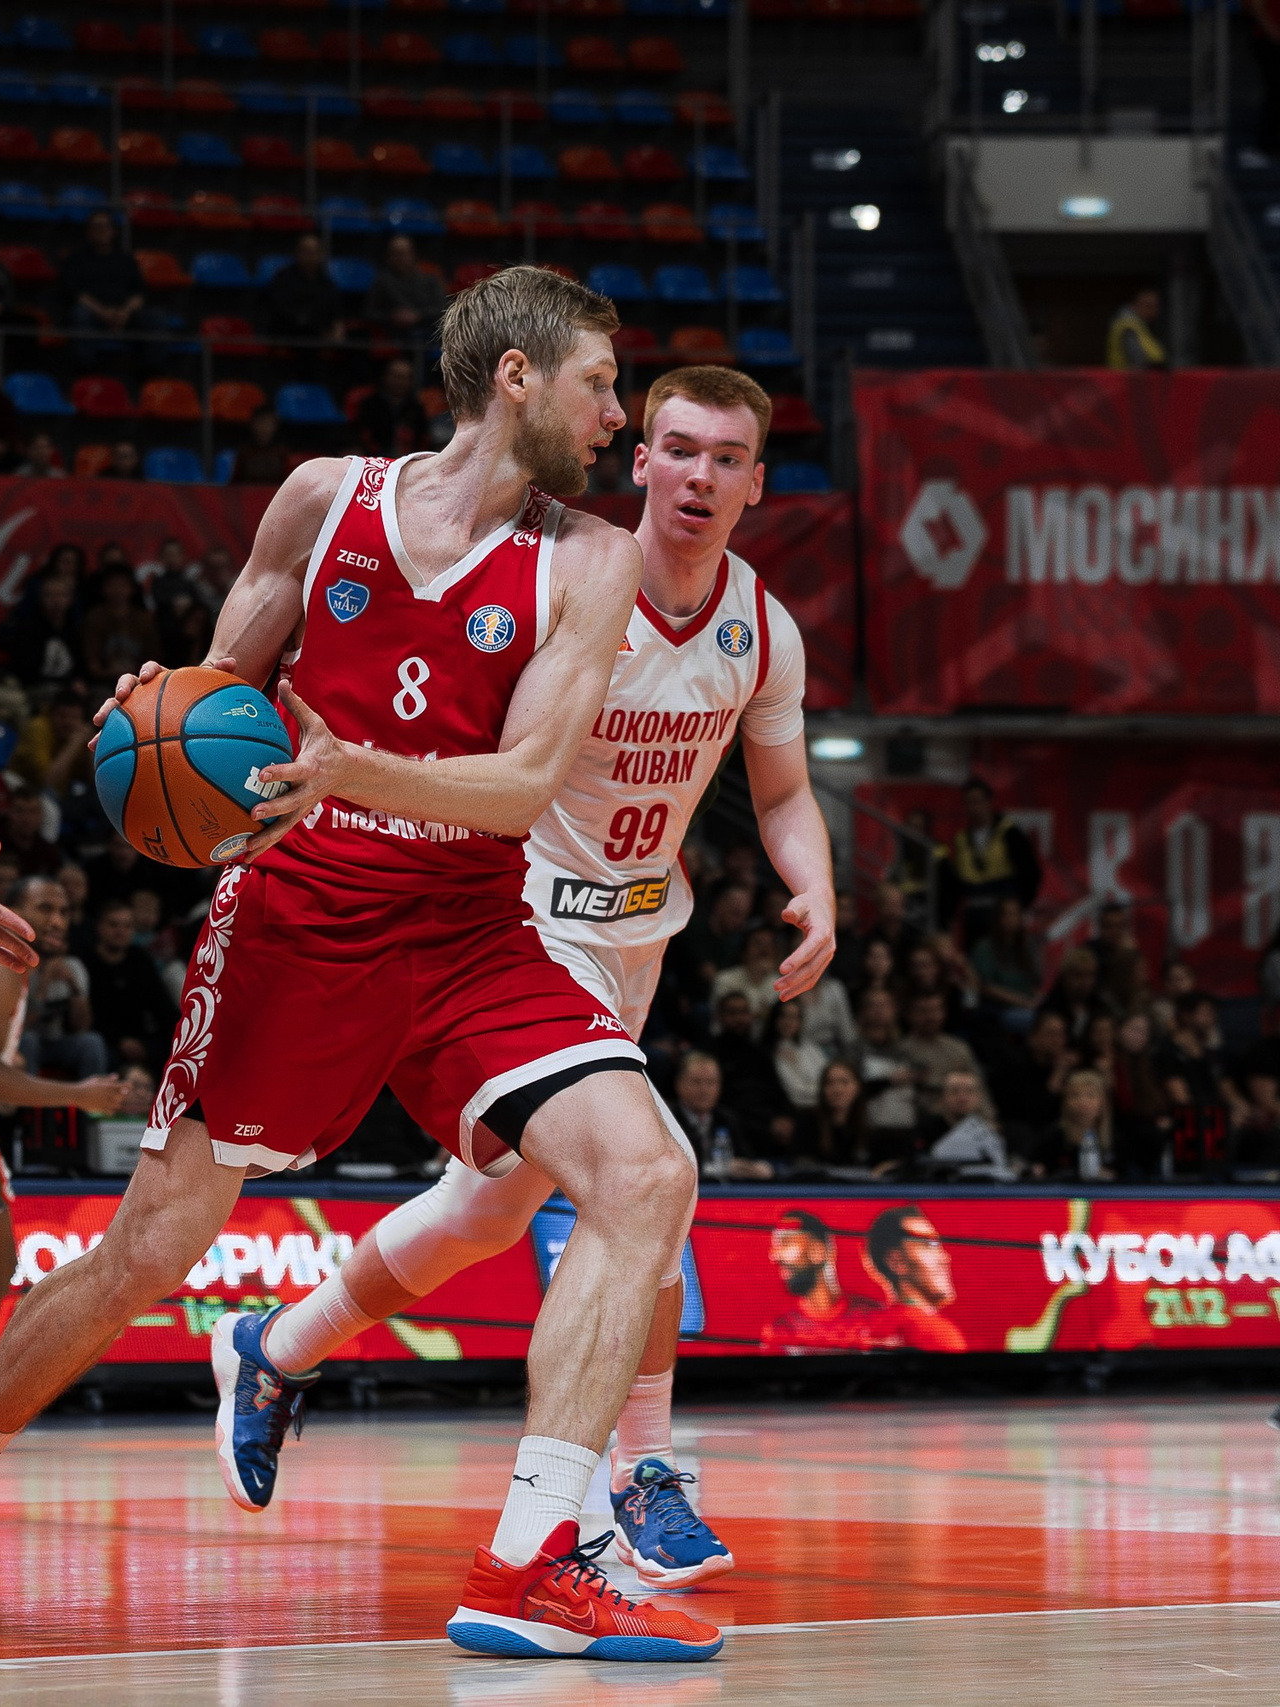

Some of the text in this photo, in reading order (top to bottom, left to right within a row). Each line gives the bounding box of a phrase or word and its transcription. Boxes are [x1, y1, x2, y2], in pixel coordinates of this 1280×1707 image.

[336, 549, 380, 572] ZEDO
[392, 656, 430, 721] 8
[611, 749, 699, 785] KUBAN
[604, 803, 668, 862] 99
[1040, 1231, 1222, 1285] КУБОК
